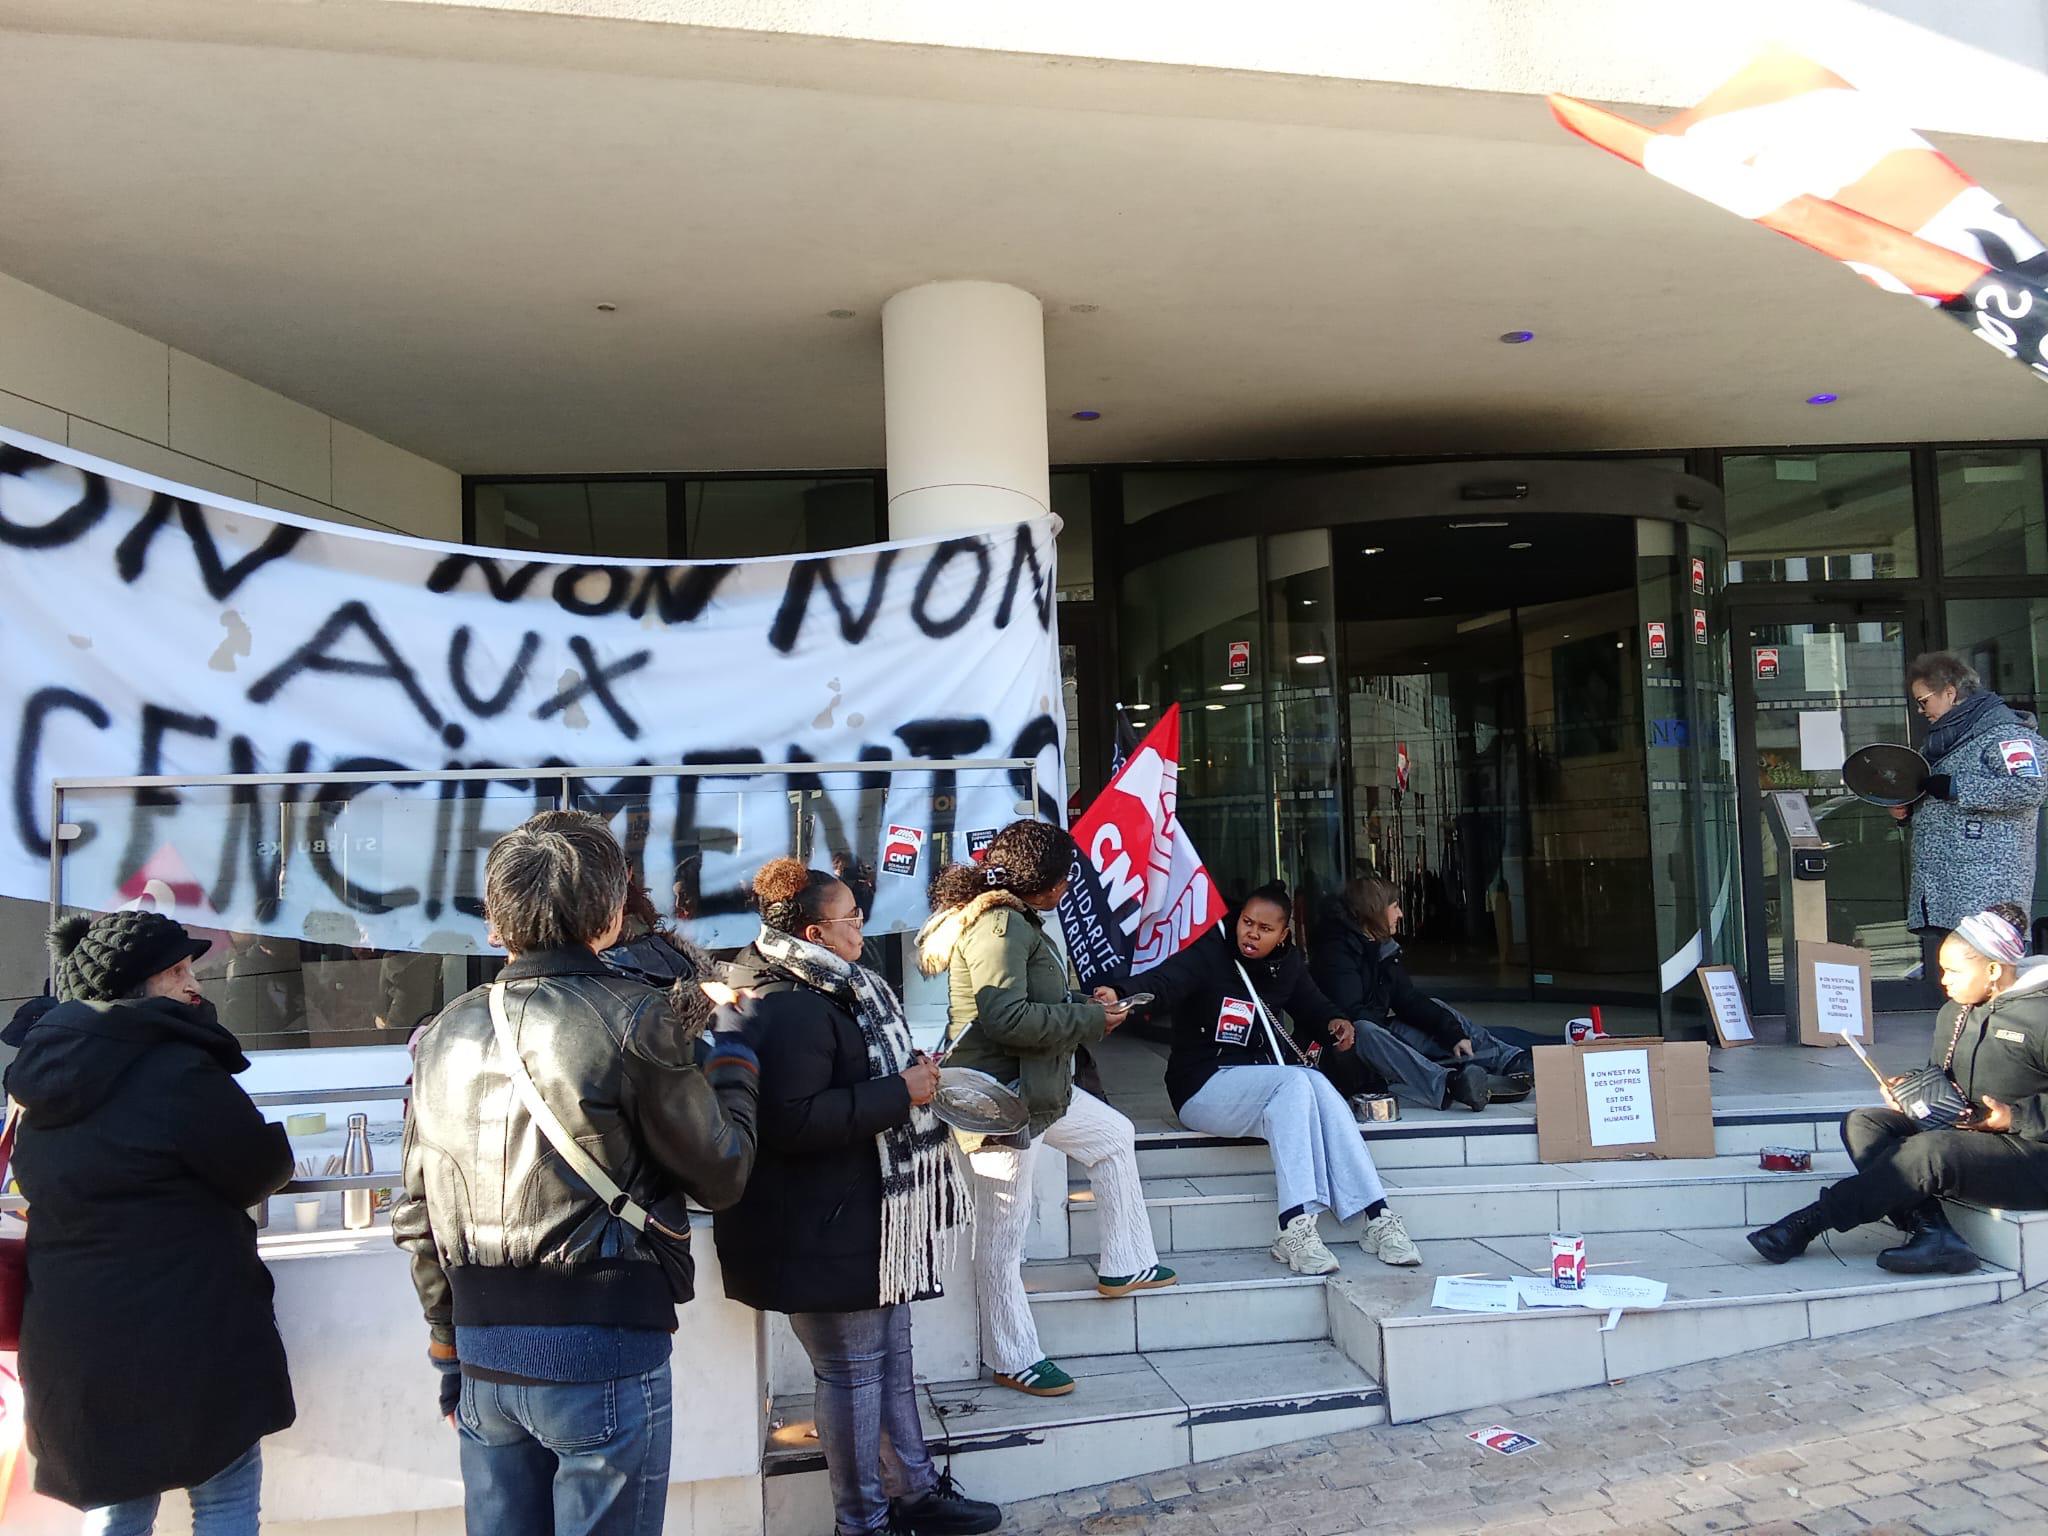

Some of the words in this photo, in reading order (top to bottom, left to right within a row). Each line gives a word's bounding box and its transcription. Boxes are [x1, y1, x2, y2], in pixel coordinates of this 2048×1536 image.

[768, 522, 1053, 654] NON
[246, 600, 652, 740] AUX
[889, 852, 913, 864] CNT
[1223, 1022, 1245, 1033] CNT
[1609, 1078, 1641, 1086] CHIFFRES
[1497, 1436, 1521, 1448] CNT
